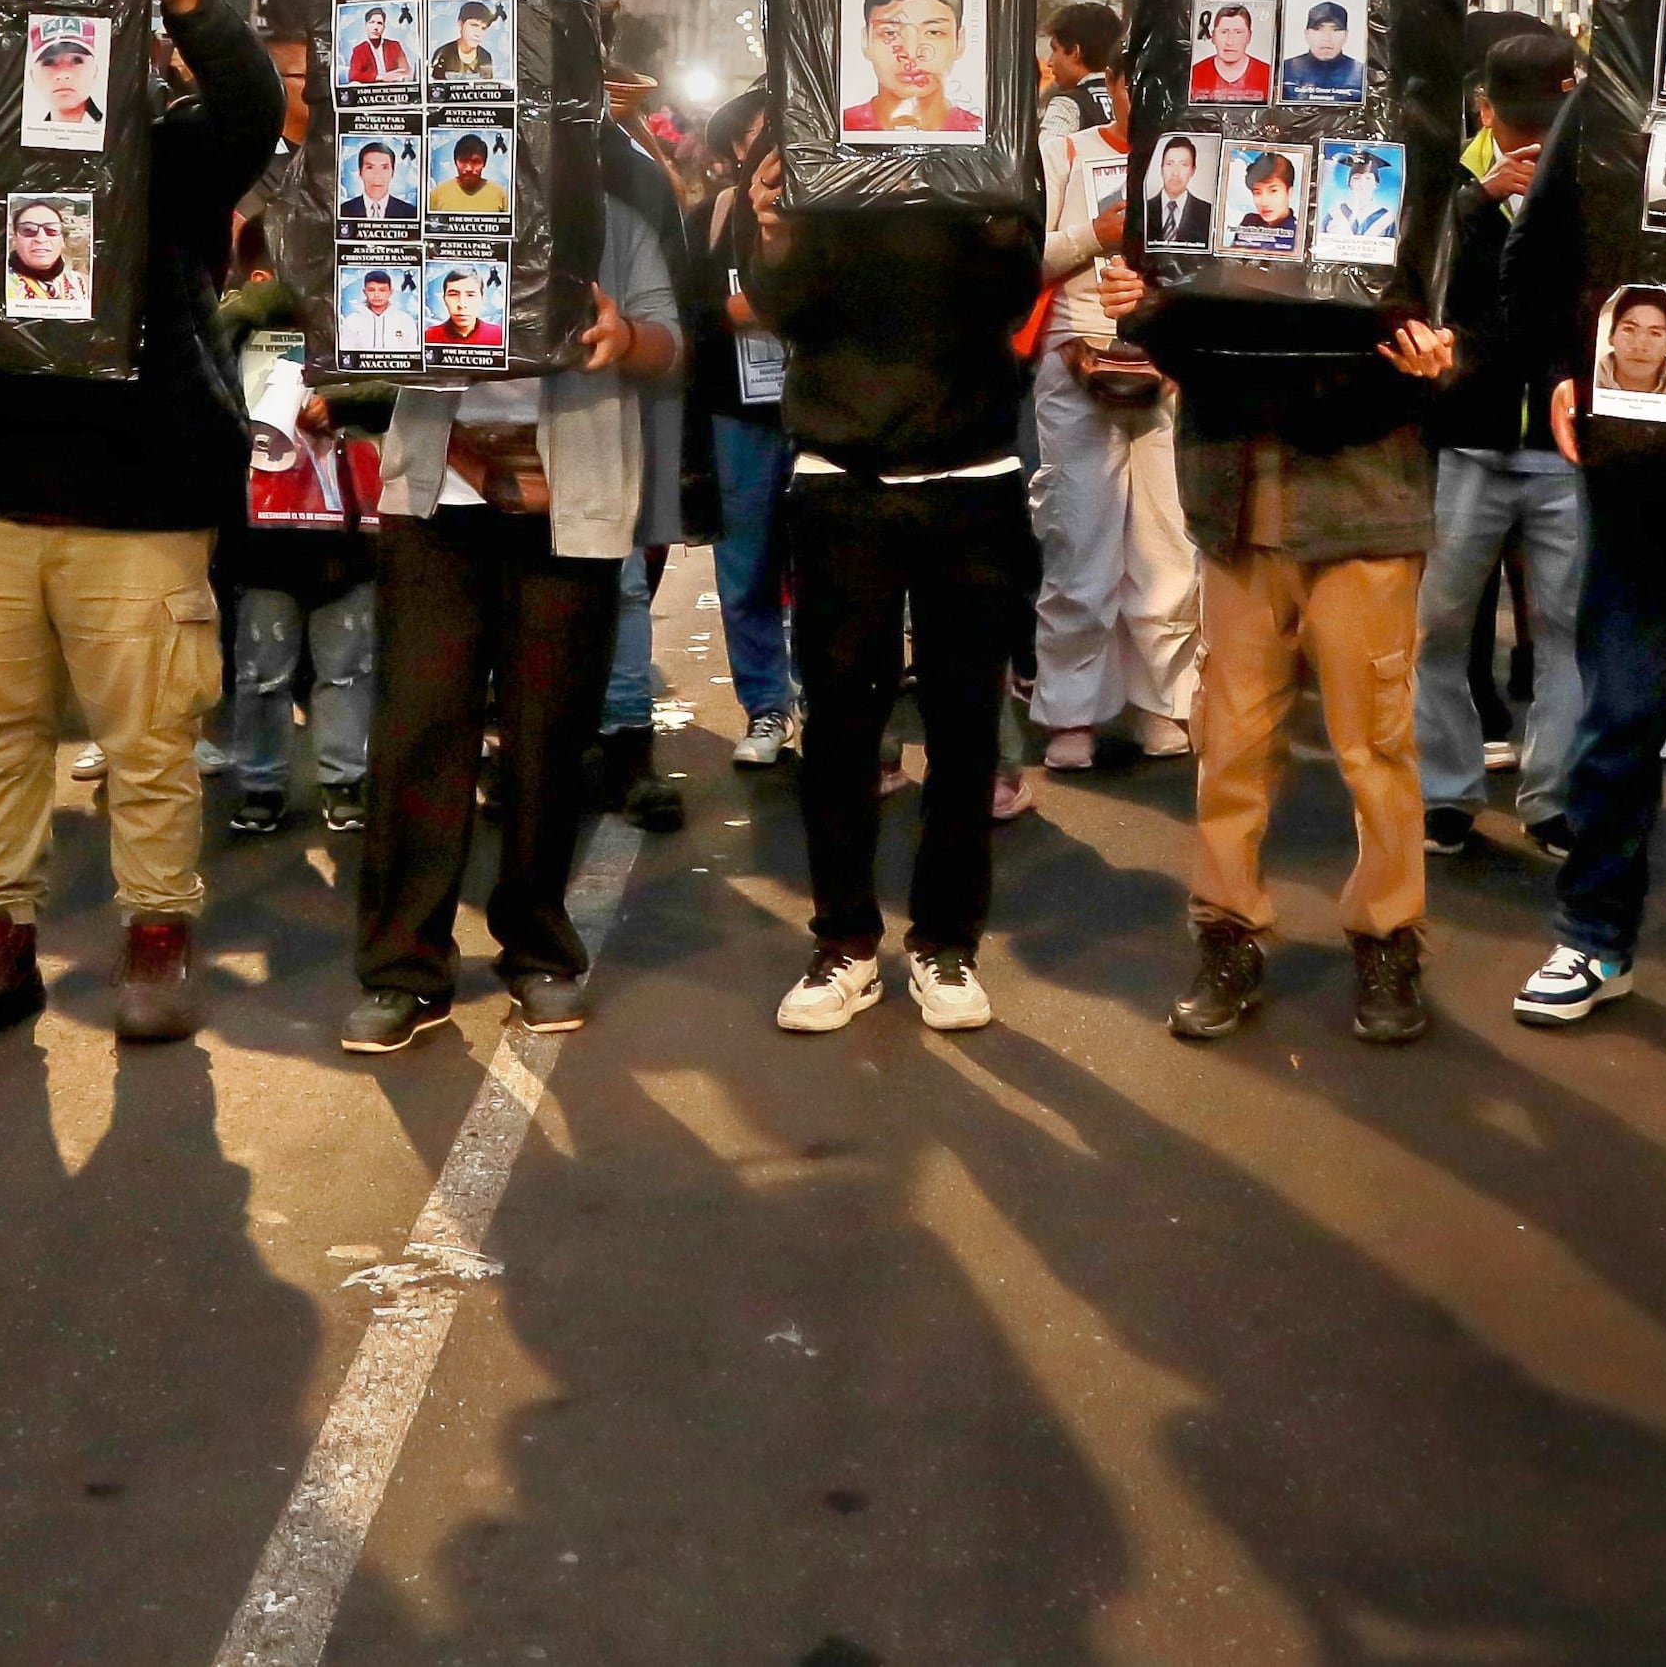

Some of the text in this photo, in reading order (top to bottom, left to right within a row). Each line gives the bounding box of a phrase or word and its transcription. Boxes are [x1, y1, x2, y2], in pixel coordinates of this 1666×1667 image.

[357, 94, 408, 104] AYACUCHO
[449, 91, 501, 100] AYACUCHO
[448, 224, 499, 232] AYACUCHO
[357, 230, 408, 238] AYACUCHO
[359, 360, 410, 368] AYACUCHO
[442, 356, 493, 365] AYACUCHO
